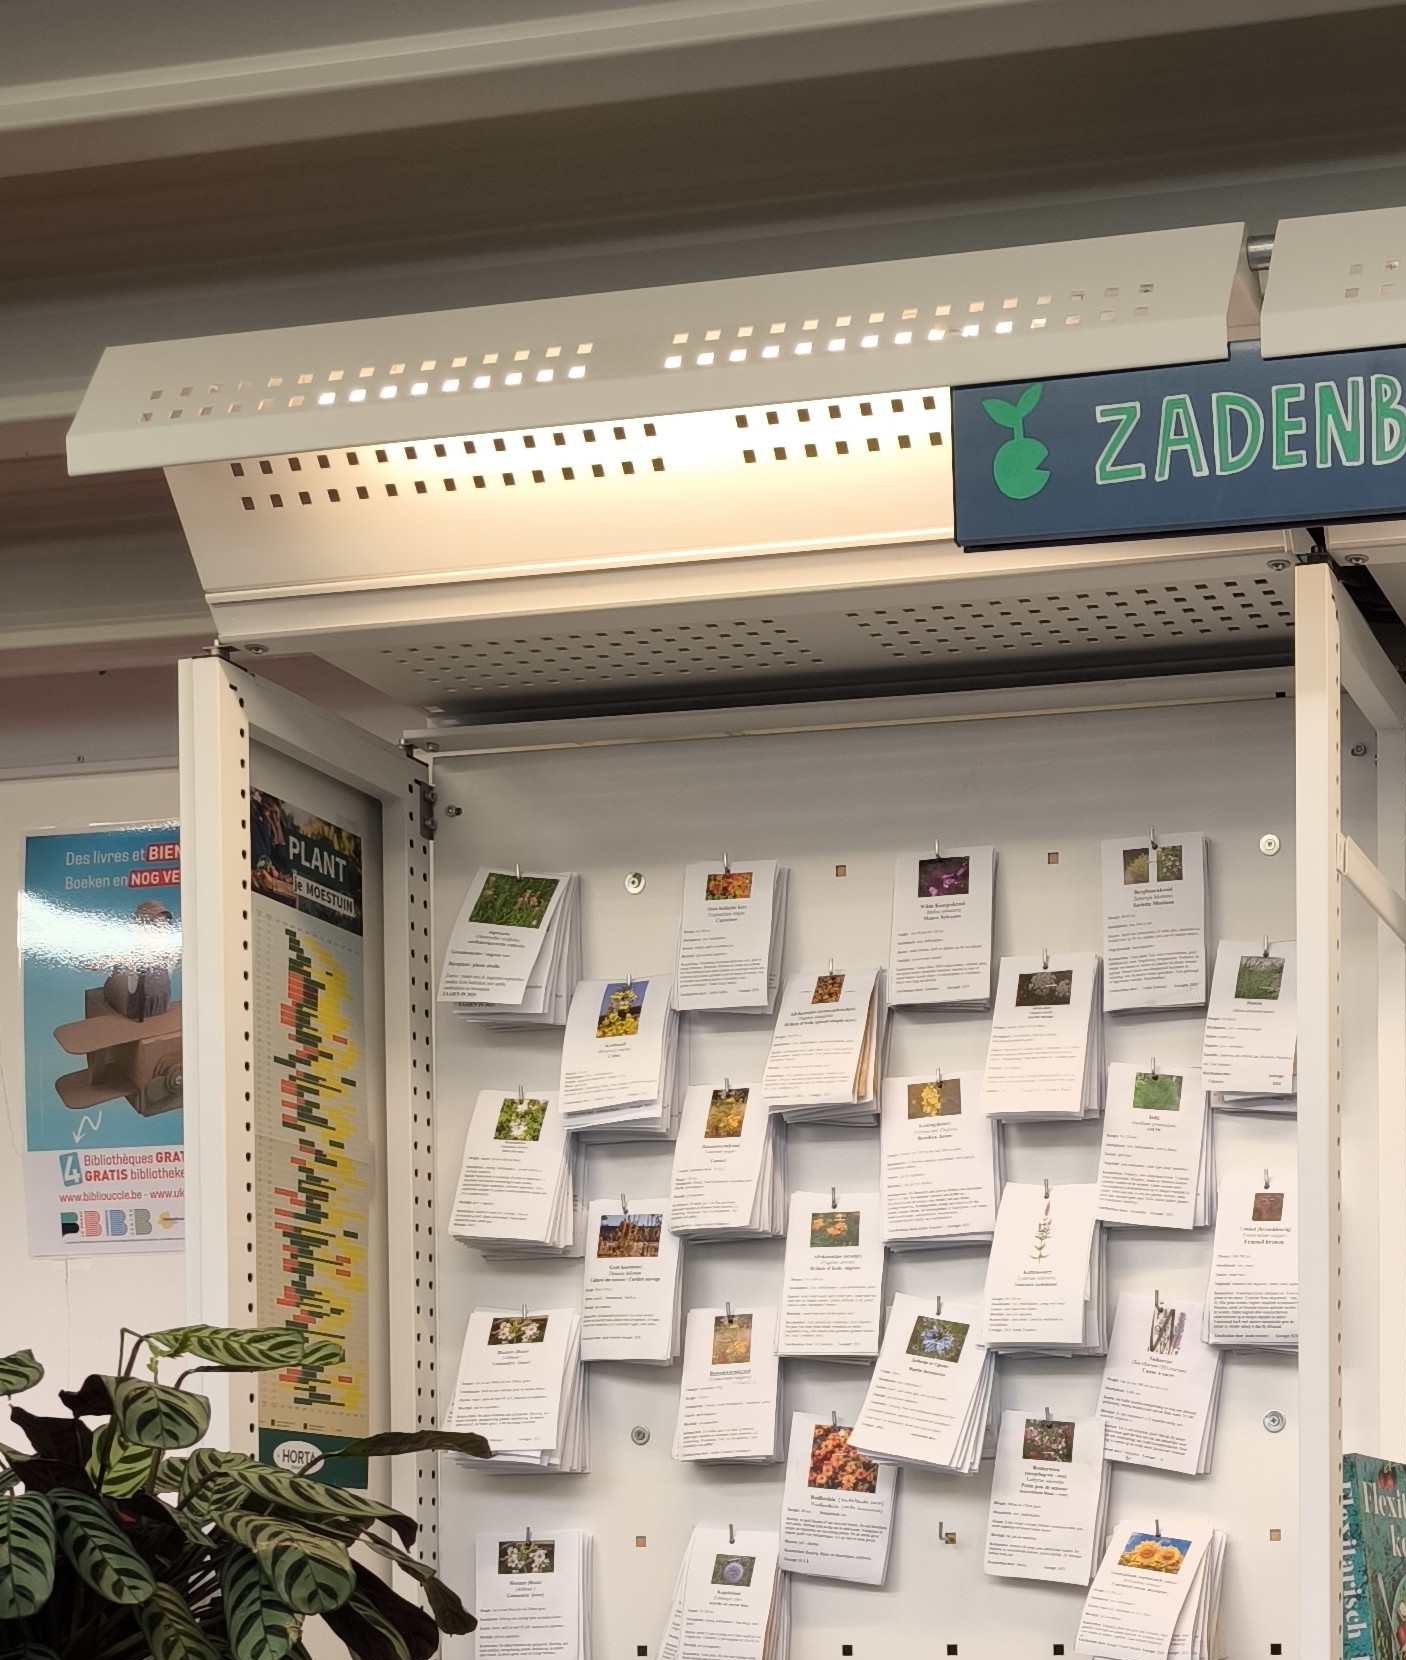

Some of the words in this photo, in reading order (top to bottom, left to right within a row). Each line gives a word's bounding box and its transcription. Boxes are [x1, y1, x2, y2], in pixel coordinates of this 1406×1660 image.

[66, 852, 90, 865] Des
[94, 850, 129, 864] livres
[133, 849, 145, 861] et
[289, 836, 346, 882] PLANT
[65, 877, 110, 889] Boeken
[113, 877, 128, 887] en
[131, 871, 159, 885] NOG
[306, 885, 353, 913] MOESTUIN
[84, 1154, 153, 1166] Bibliothèques
[85, 1169, 128, 1181] GRATIS
